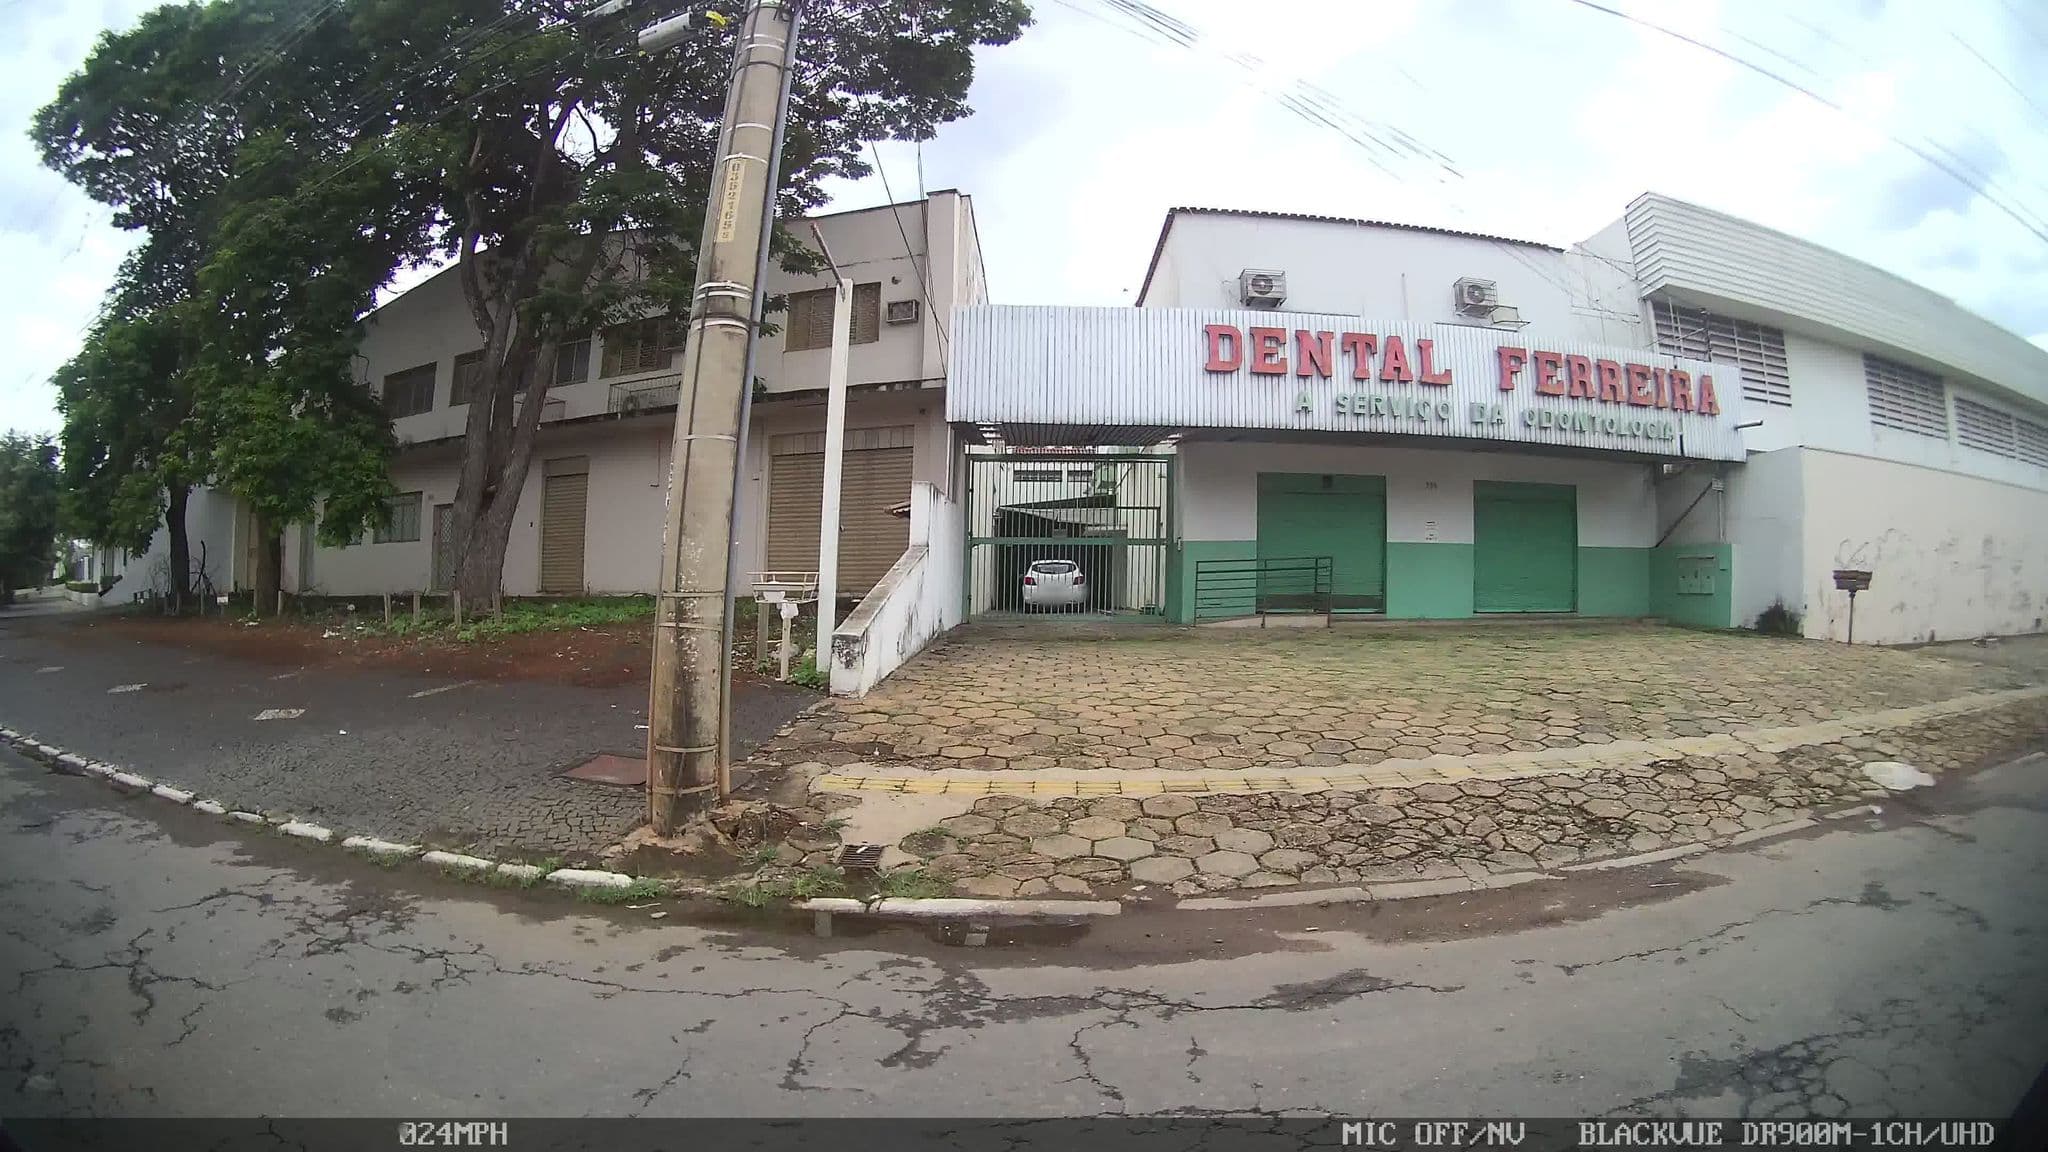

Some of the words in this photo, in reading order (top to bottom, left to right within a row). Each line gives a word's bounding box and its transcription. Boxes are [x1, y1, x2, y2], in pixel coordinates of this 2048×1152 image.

[1204, 324, 1453, 386] DENTAL
[1496, 345, 1721, 416] FERREIRA
[1295, 390, 1314, 414] A
[1336, 391, 1451, 421] SERVIÇO
[1469, 401, 1506, 426] DA
[1524, 406, 1675, 442] ODONTOLOGIA
